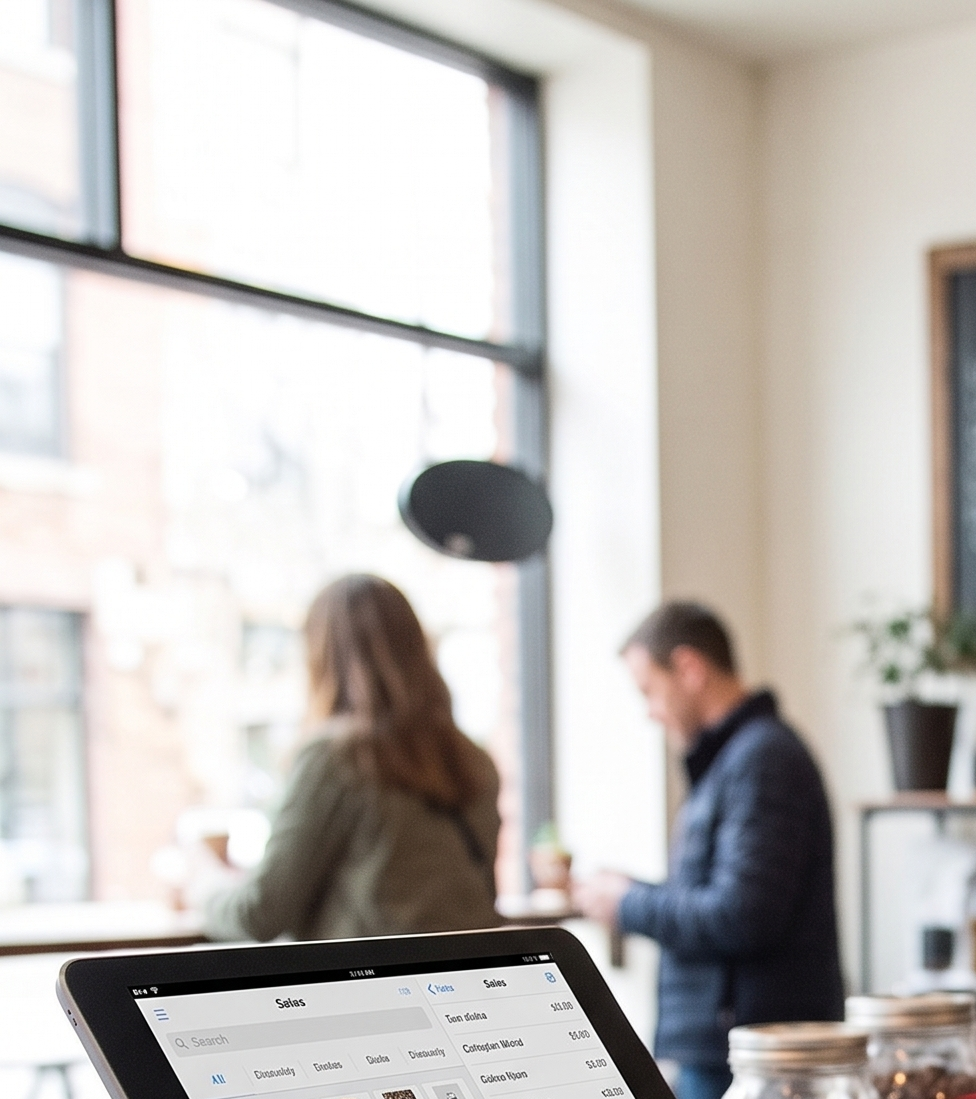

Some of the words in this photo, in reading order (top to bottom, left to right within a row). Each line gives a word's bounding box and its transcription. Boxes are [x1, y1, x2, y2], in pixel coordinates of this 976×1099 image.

[483, 979, 507, 989] Sales
[191, 1034, 229, 1048] Search
[211, 1074, 226, 1085] All
